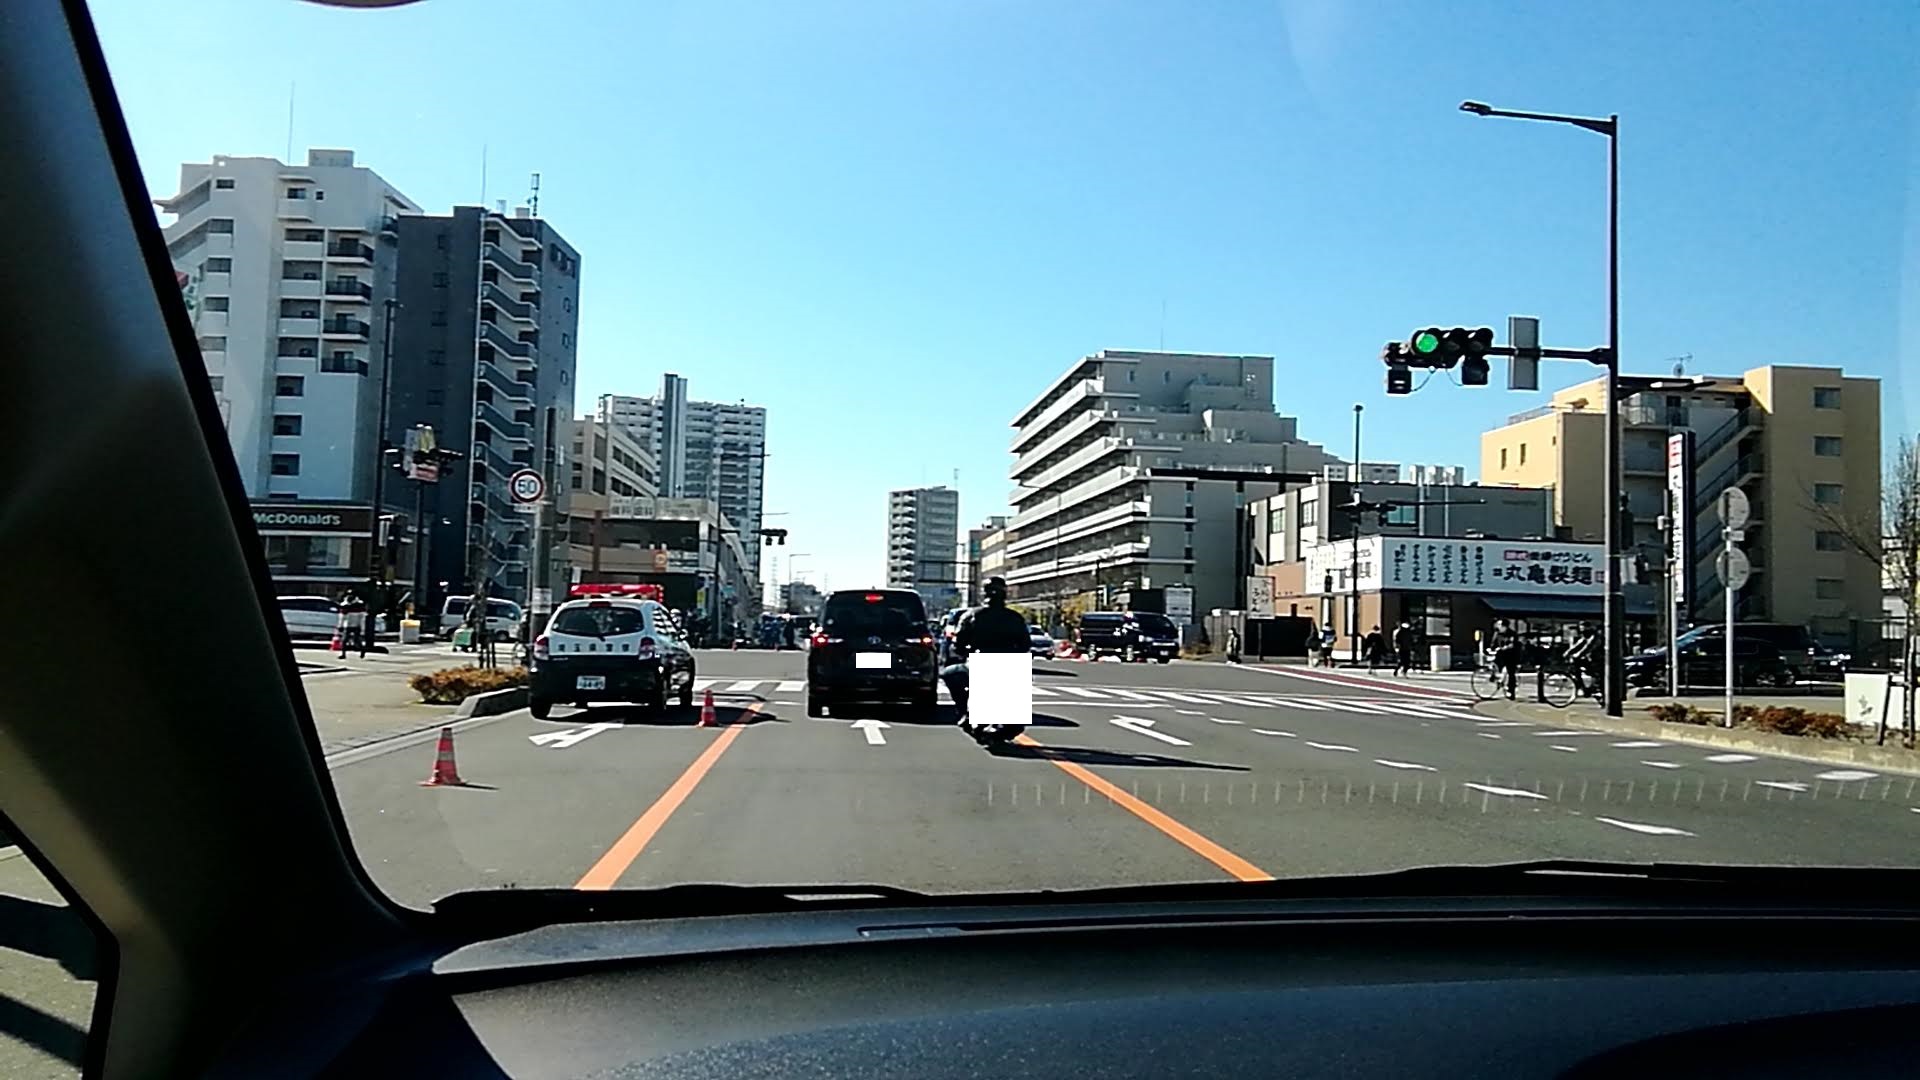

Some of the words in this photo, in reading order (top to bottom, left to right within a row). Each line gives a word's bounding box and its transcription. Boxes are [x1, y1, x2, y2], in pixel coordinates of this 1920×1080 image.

[518, 480, 537, 494] 50
[253, 512, 341, 526] McDonald's
[1504, 564, 1592, 585] 丸亀製麺
